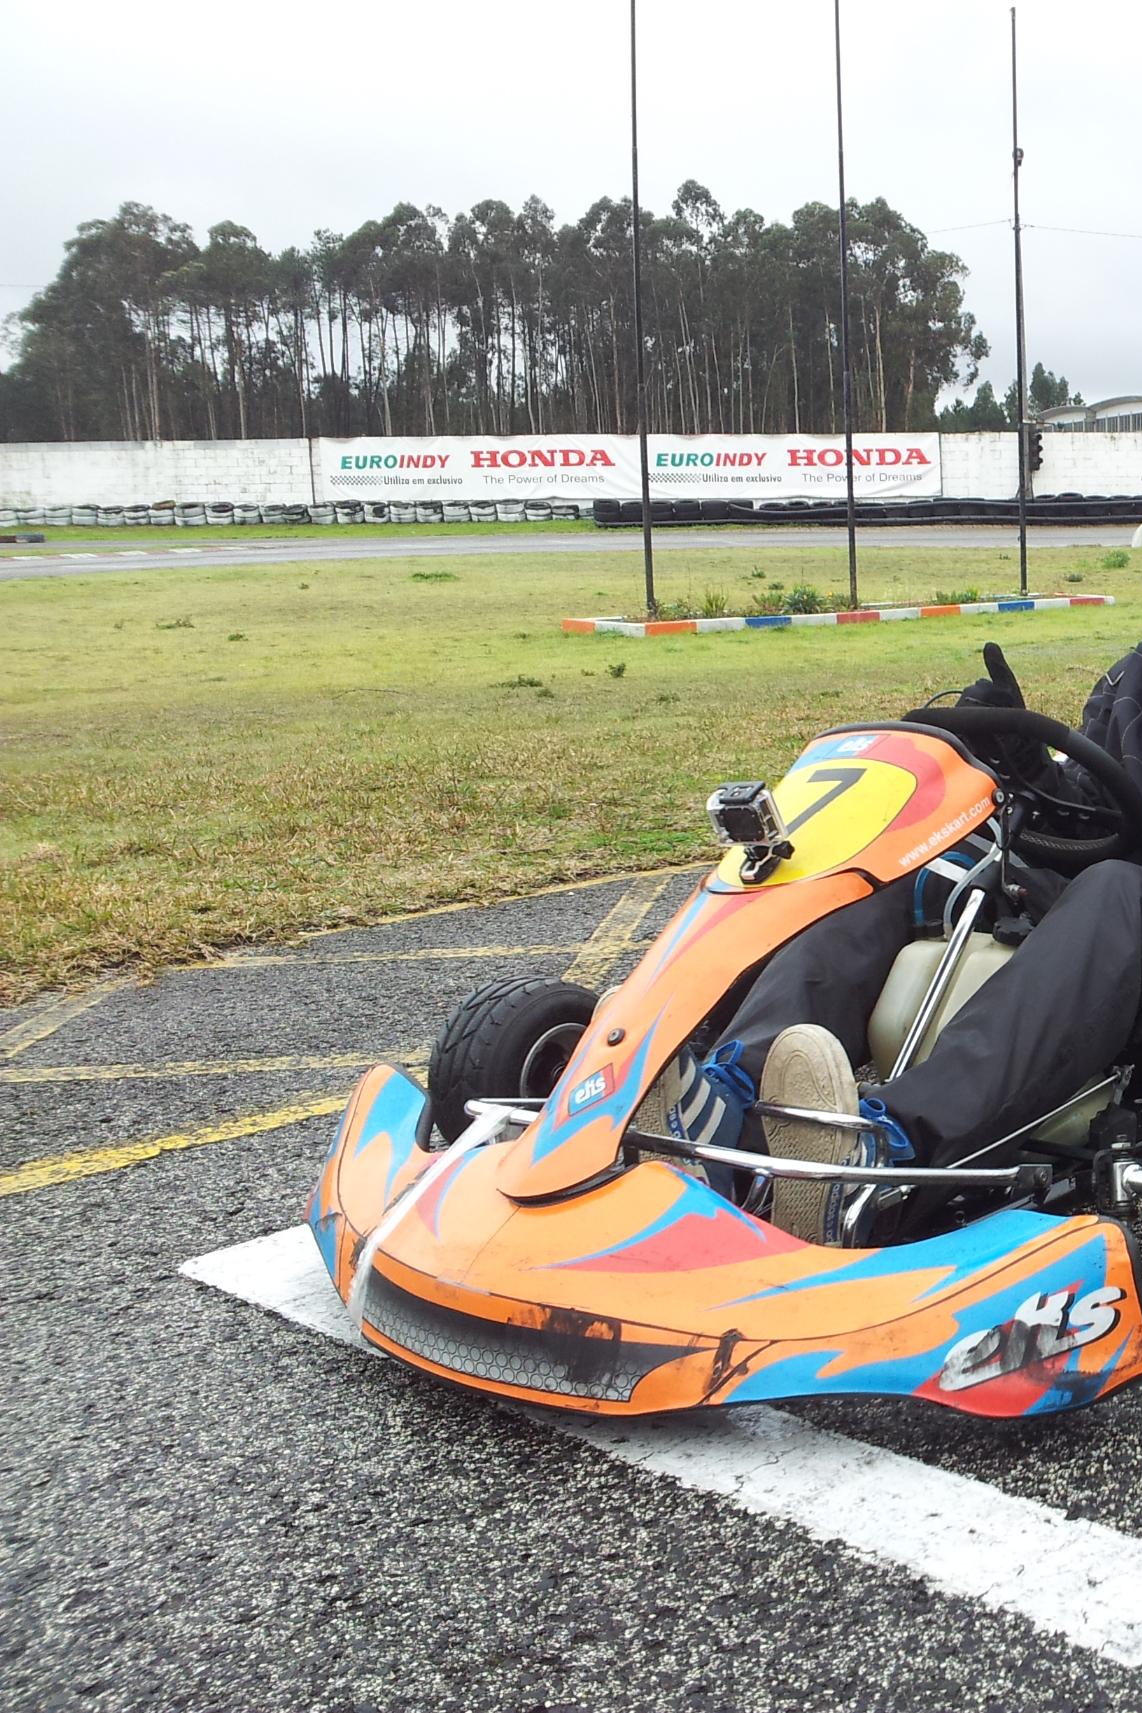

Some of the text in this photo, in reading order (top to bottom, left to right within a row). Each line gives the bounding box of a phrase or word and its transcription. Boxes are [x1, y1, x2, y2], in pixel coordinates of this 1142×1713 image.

[340, 454, 450, 470] EUROINDY
[470, 449, 616, 468] HONDA
[656, 452, 767, 467] EUROINDY
[787, 448, 931, 467] HONDA
[384, 476, 410, 485] Utiliza
[427, 476, 463, 485] exclusivo
[483, 473, 605, 484] The Power of Dreams
[702, 473, 729, 483] Utiliza
[746, 473, 782, 483] exclusivo
[802, 473, 823, 483] The
[865, 473, 876, 482] of
[879, 472, 923, 482] Dreams
[786, 768, 867, 836] 7
[898, 797, 991, 867] www.ekskart.com
